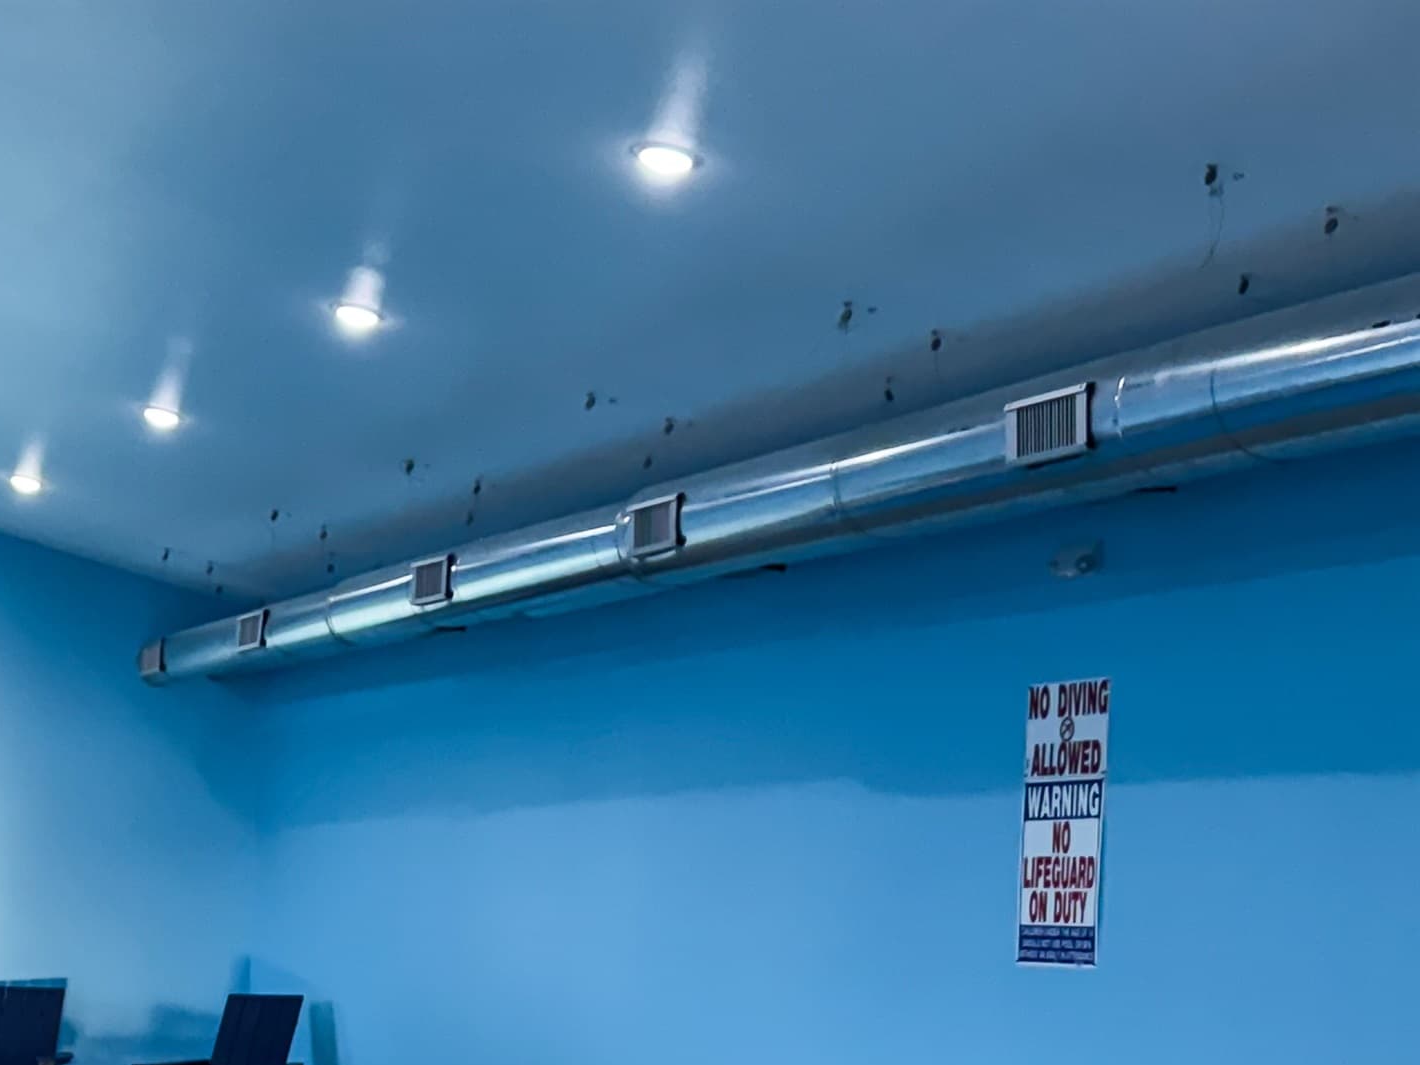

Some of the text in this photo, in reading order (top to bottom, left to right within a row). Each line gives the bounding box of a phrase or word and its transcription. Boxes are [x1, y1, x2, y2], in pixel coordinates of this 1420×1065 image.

[1028, 679, 1109, 720] NO DIVING
[1031, 739, 1101, 777] ALLOWED
[1028, 782, 1100, 818] WARNING
[1052, 821, 1071, 854] NO
[1023, 855, 1095, 889] LIFEGUARD
[1029, 890, 1088, 923] ON DUTY
